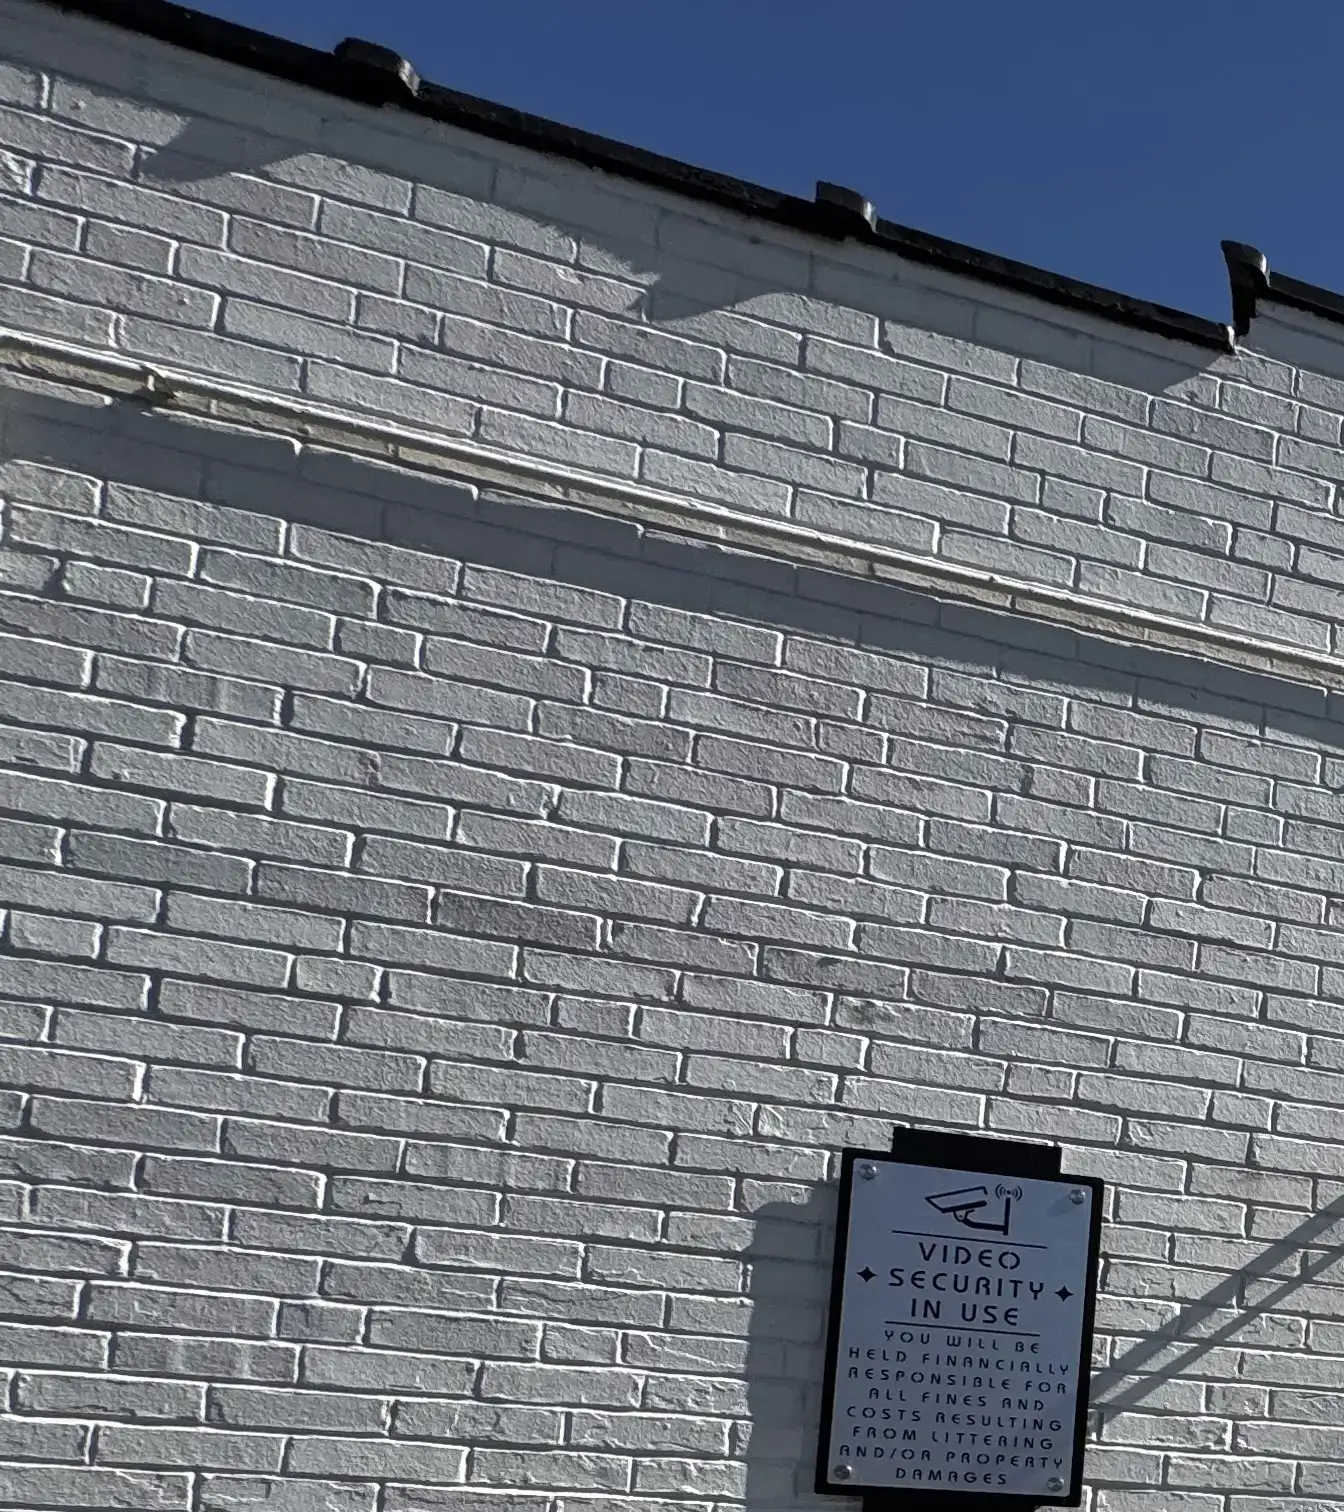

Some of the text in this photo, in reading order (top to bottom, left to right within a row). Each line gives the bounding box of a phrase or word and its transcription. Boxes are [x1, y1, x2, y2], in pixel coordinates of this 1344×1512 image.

[918, 1242, 1021, 1270] VIDEO
[888, 1267, 1044, 1300] SECURITY
[910, 1298, 1019, 1326] IN USE
[884, 1330, 1040, 1354] YOU WILL BE
[848, 1347, 1069, 1376] HELD FINANCIALLY
[848, 1367, 1067, 1394] RESPONSIBLE FOR
[868, 1387, 1045, 1411] ALL FINES AND
[846, 1405, 1062, 1431] COSTS RESULTING
[852, 1425, 1053, 1450] FROM LITTERING
[839, 1445, 1063, 1469] AND/OR PROPERTY
[896, 1468, 1008, 1485] DAMAGES
